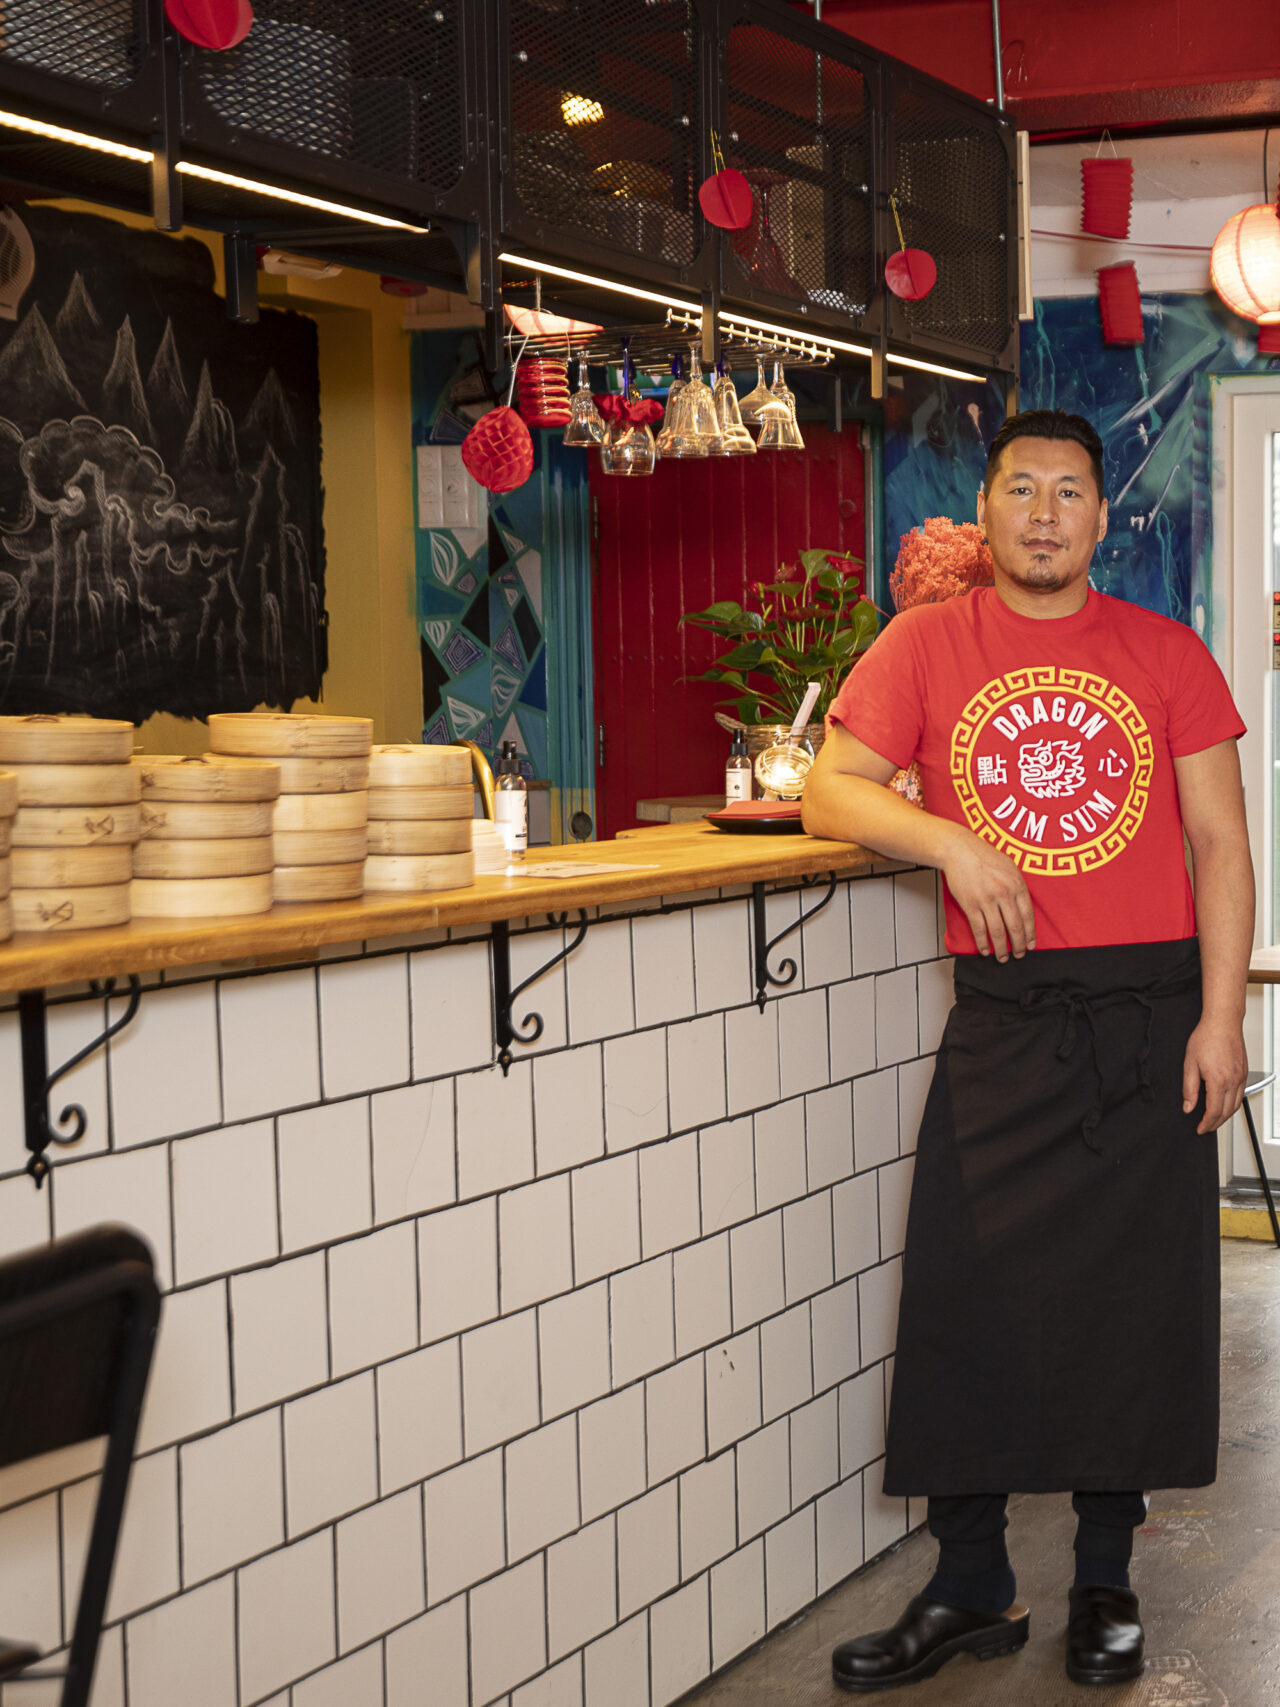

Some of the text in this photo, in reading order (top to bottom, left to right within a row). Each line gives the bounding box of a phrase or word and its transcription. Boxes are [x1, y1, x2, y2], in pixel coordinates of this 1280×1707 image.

[992, 696, 1108, 741] DRAGON
[977, 748, 1128, 785] 點 心
[992, 789, 1117, 842] DIM SUM
